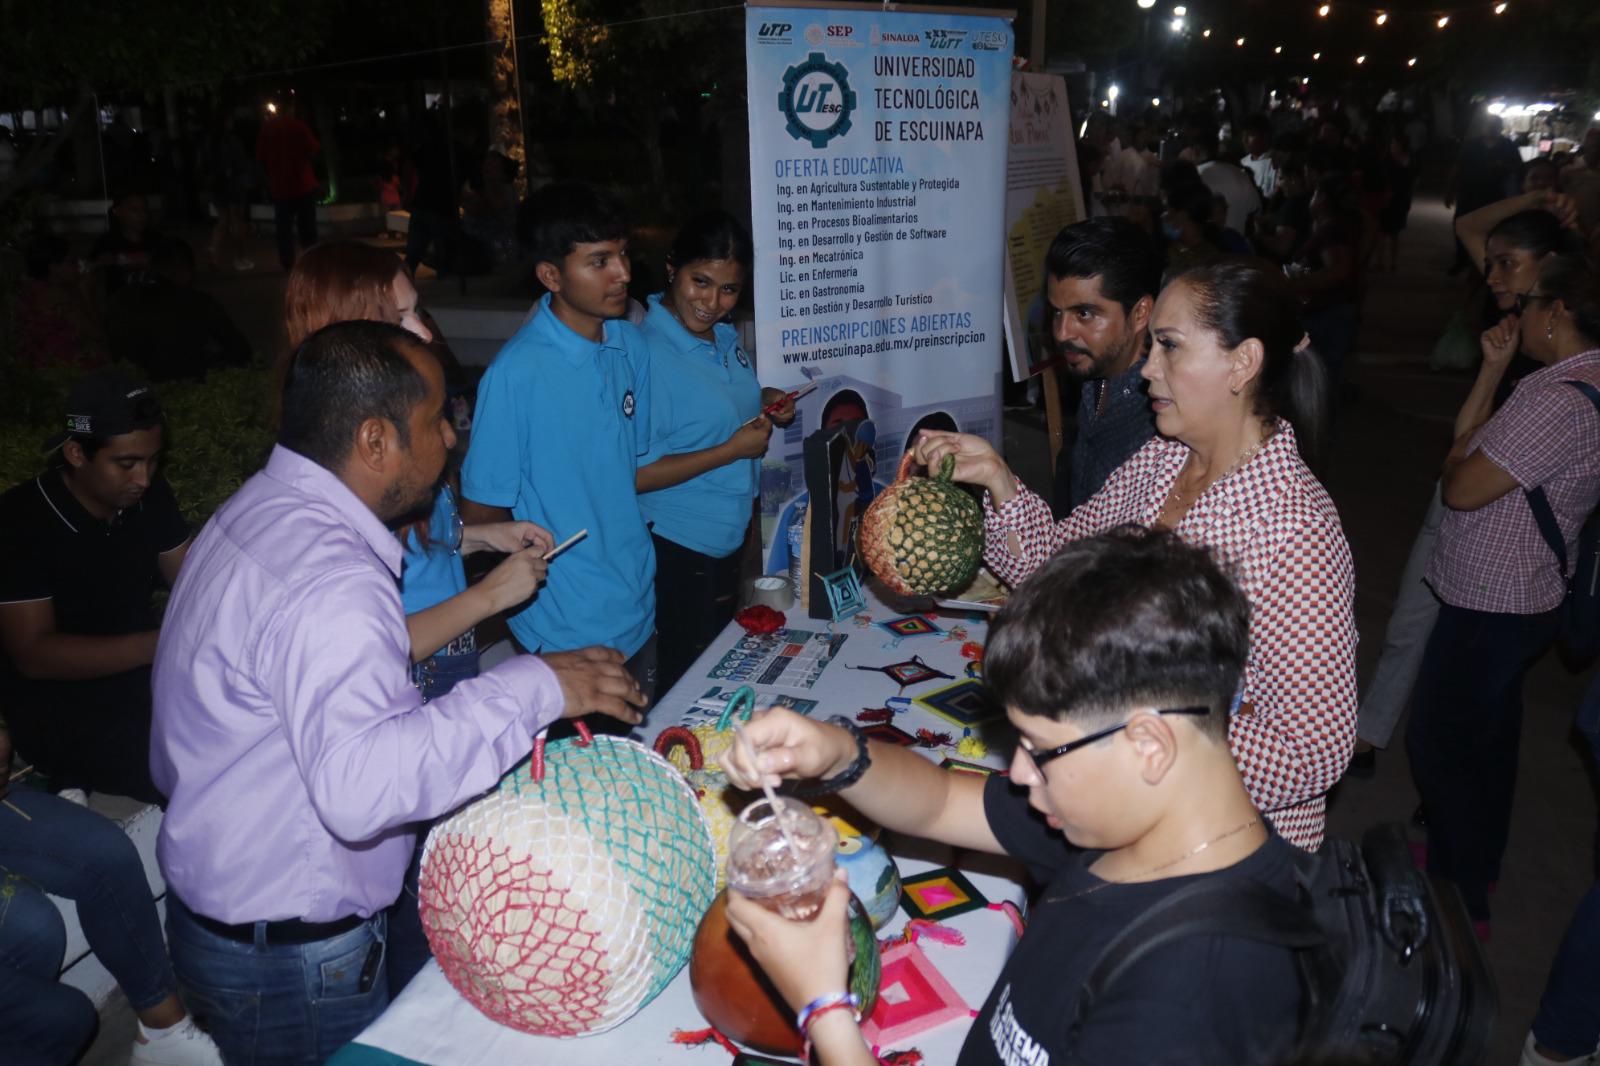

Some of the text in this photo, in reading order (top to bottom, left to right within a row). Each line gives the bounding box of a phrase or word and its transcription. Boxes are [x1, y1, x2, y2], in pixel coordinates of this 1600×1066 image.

[827, 25, 853, 36] SEP
[882, 32, 920, 43] SINALOA
[874, 56, 975, 78] UNIVERSIDAD
[874, 84, 979, 110] TECNOLÓGICA
[875, 121, 984, 141] DE ESCUINAPA
[775, 156, 904, 178] OFERTA EDUCATIVA
[777, 178, 960, 197] Ing. en Agricultura Sustentable y Protegida
[777, 195, 916, 215] Ing. en Mantenimiento Industrial
[778, 212, 918, 233] Ing. en Procesos Bioalimentarios
[778, 236, 796, 251] Ing.
[798, 237, 809, 247] en
[812, 233, 854, 247] Desarrollo
[856, 235, 862, 246] y
[895, 229, 907, 240] de
[910, 228, 947, 241] Software
[779, 249, 864, 268] Ing. en Mecatrónica
[780, 271, 796, 283] Lic.
[798, 272, 810, 282] en
[780, 289, 796, 301] Lic.
[799, 289, 810, 299] en
[781, 306, 797, 318] Lic.
[799, 307, 810, 316] en
[845, 303, 850, 314] y
[852, 297, 893, 311] Desarrollo
[782, 312, 972, 348] PREINSCRIPCIONES ABIERTAS
[783, 331, 986, 365] www.utescuinapa.edu.mx/preinscripcion
